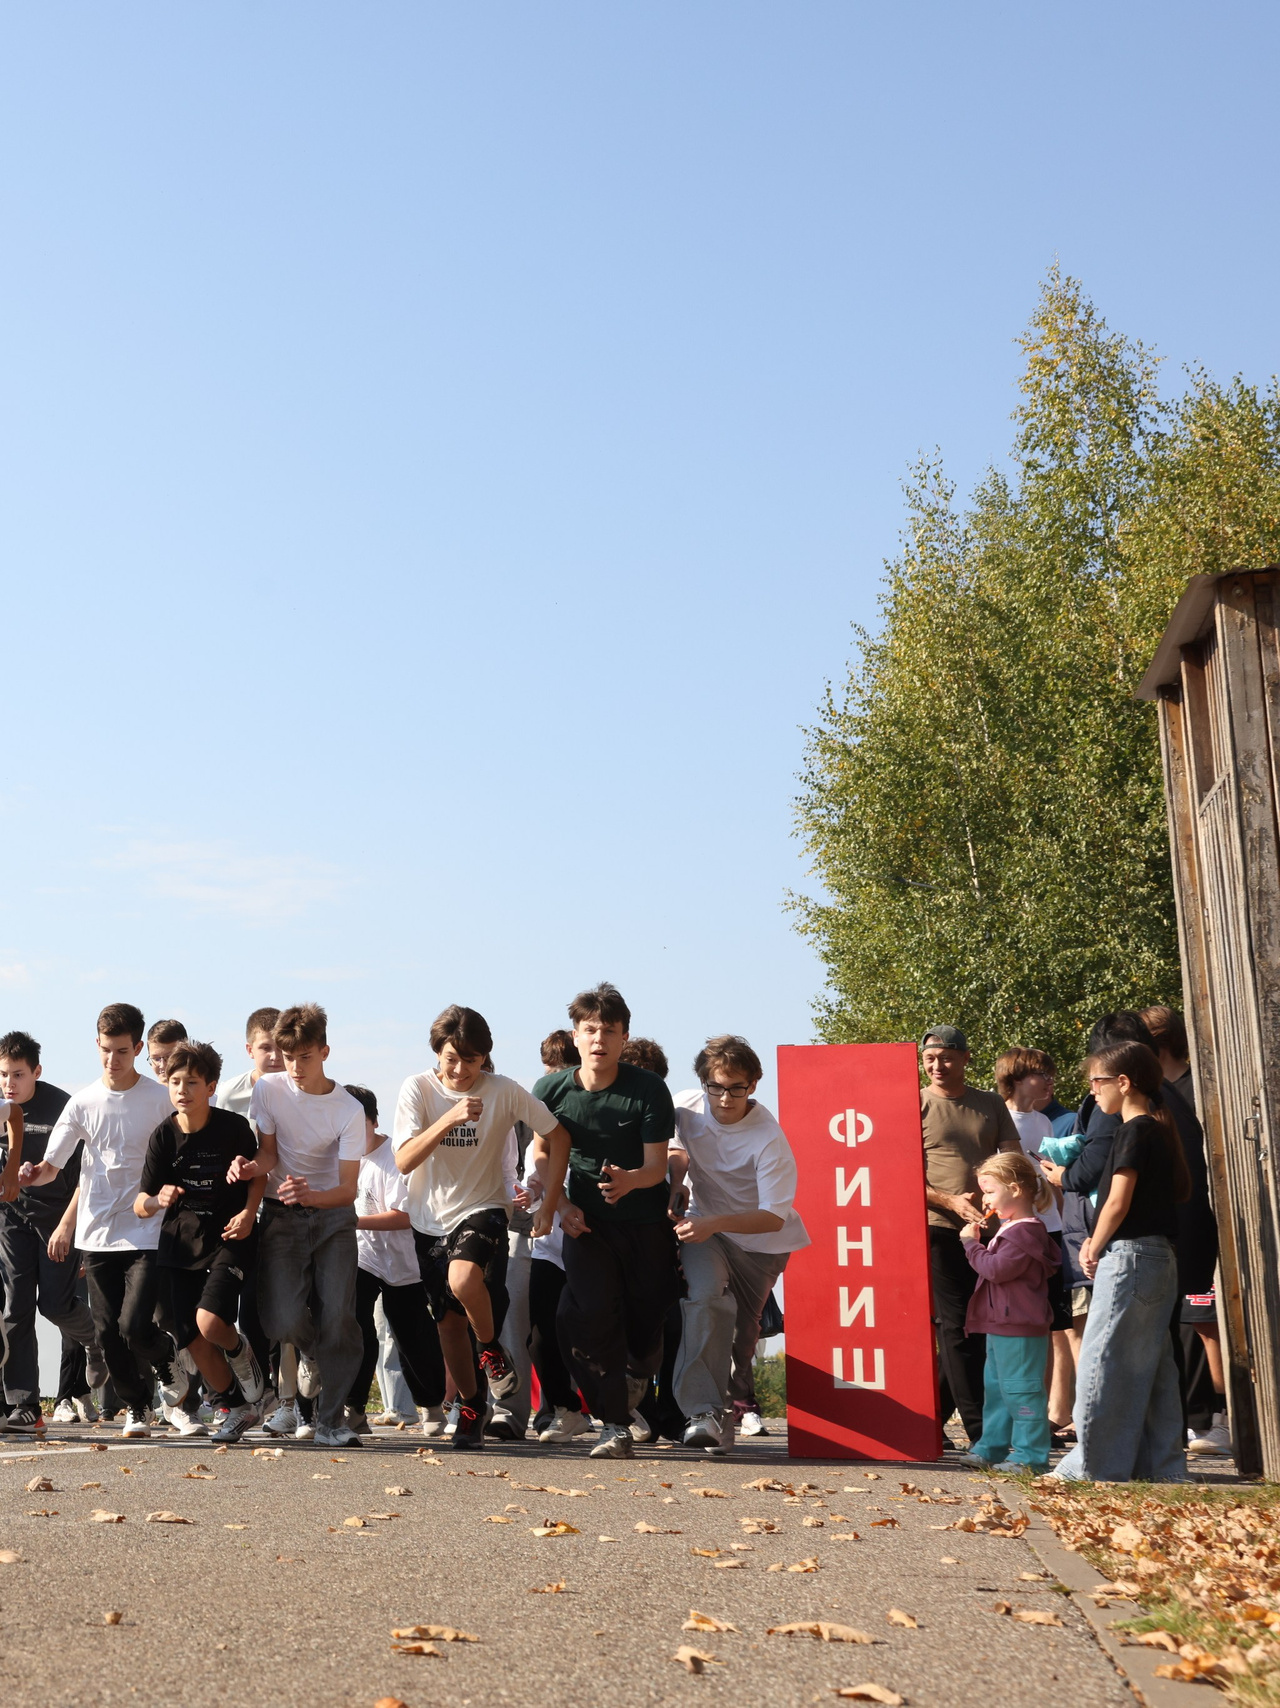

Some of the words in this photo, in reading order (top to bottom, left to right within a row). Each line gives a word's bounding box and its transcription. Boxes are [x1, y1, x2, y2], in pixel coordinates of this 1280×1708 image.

[460, 1127, 477, 1138] DAY
[440, 1137, 479, 1148] HOLID#Y
[828, 1108, 886, 1390] ФИНИШ
